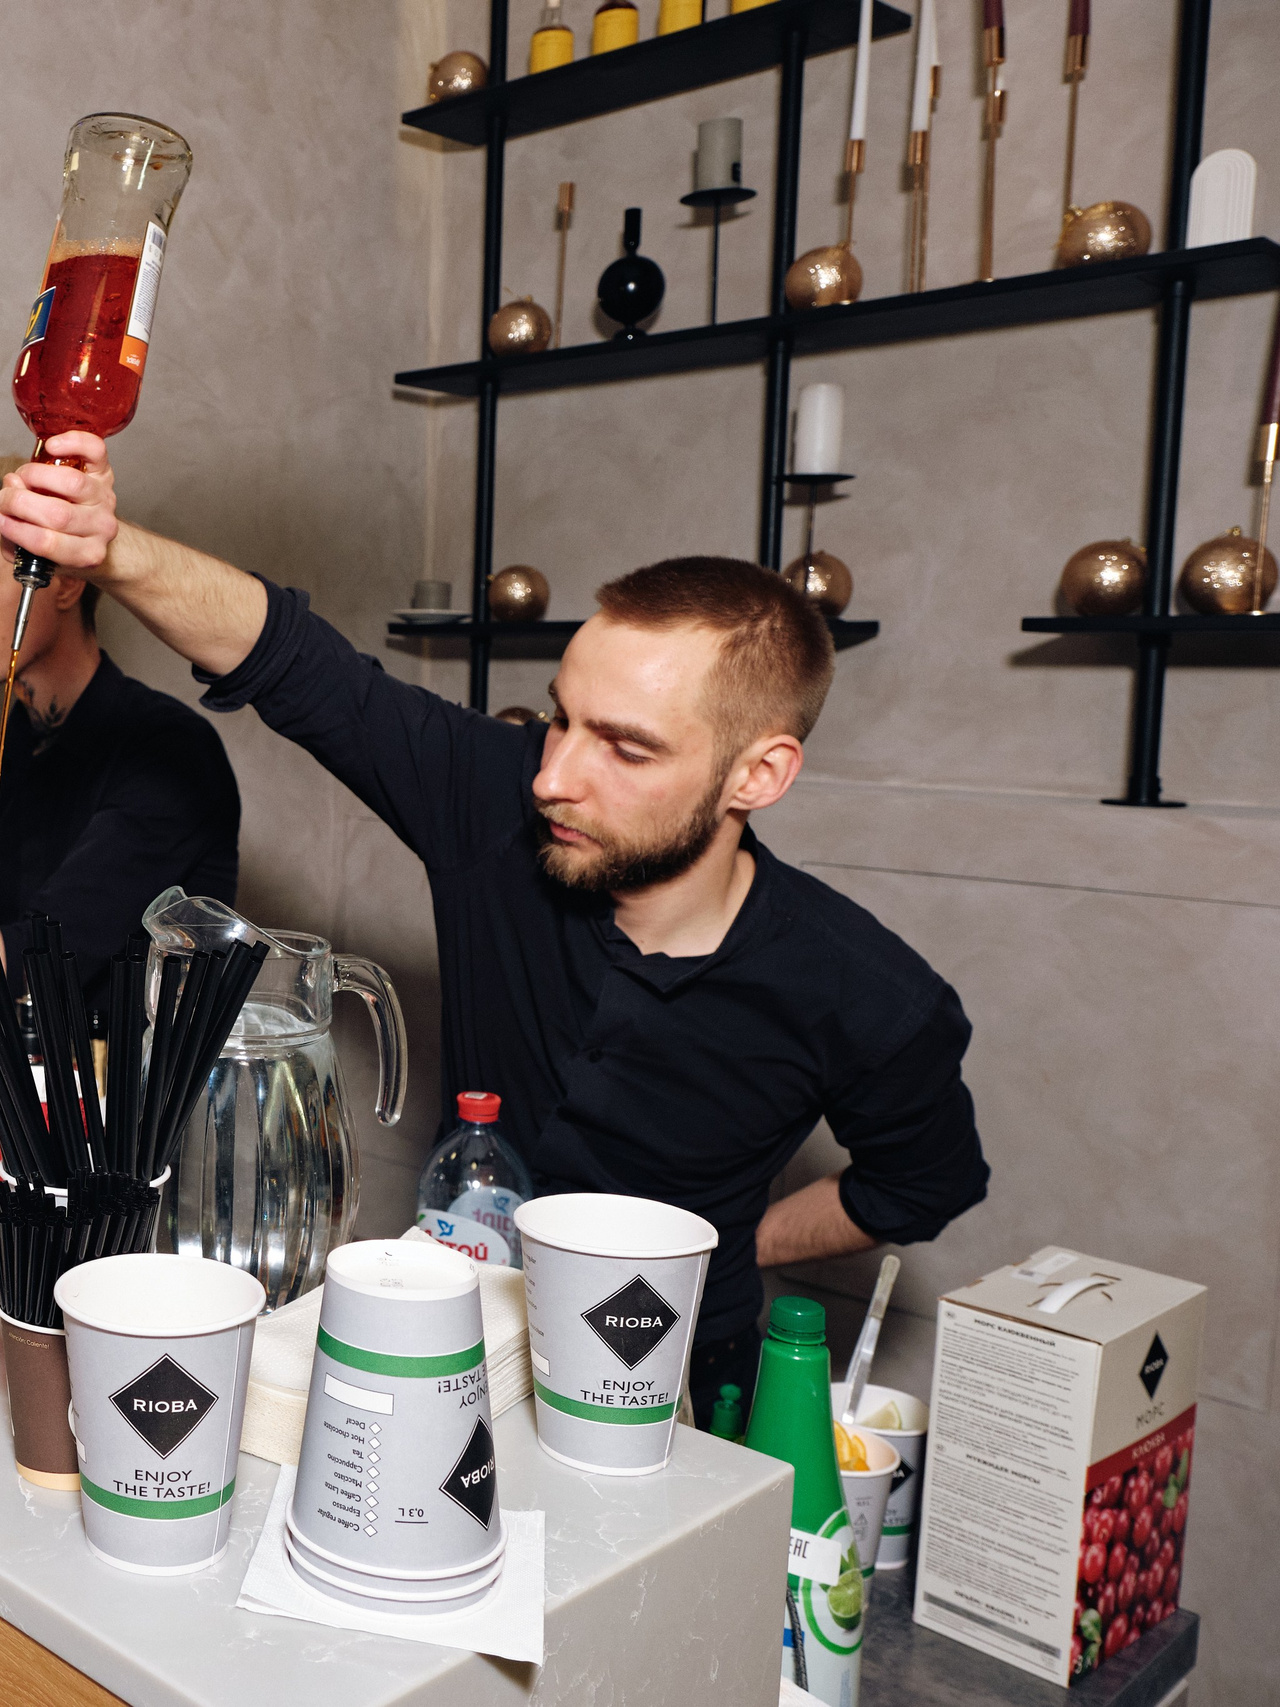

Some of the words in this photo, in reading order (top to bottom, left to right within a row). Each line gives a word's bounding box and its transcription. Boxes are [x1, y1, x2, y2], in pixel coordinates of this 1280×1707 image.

[605, 1315, 663, 1328] RIOBA
[974, 1318, 996, 1331] МОРС
[997, 1326, 1056, 1347] КЛЮКВЕННЫЙ
[603, 1380, 655, 1394] ENJOY
[580, 1390, 614, 1405] THE
[619, 1392, 669, 1406] TASTE!
[133, 1399, 198, 1413] RIOBA
[1136, 1401, 1165, 1429] МОРС
[323, 1421, 350, 1438] chocolate
[345, 1418, 366, 1430] Decaf
[351, 1434, 365, 1444] Hot
[352, 1449, 364, 1459] Tea
[327, 1453, 363, 1473] Cappuccino
[135, 1470, 192, 1485] ENJOY
[333, 1471, 362, 1488] Macciato
[460, 1455, 495, 1489] RIOBA
[113, 1480, 147, 1497] THE
[153, 1482, 211, 1498] TASTE!
[324, 1481, 339, 1495] Latte
[317, 1508, 336, 1521] regular
[332, 1501, 361, 1517] Espresso
[398, 1507, 406, 1517] L
[337, 1517, 360, 1532] Coffee
